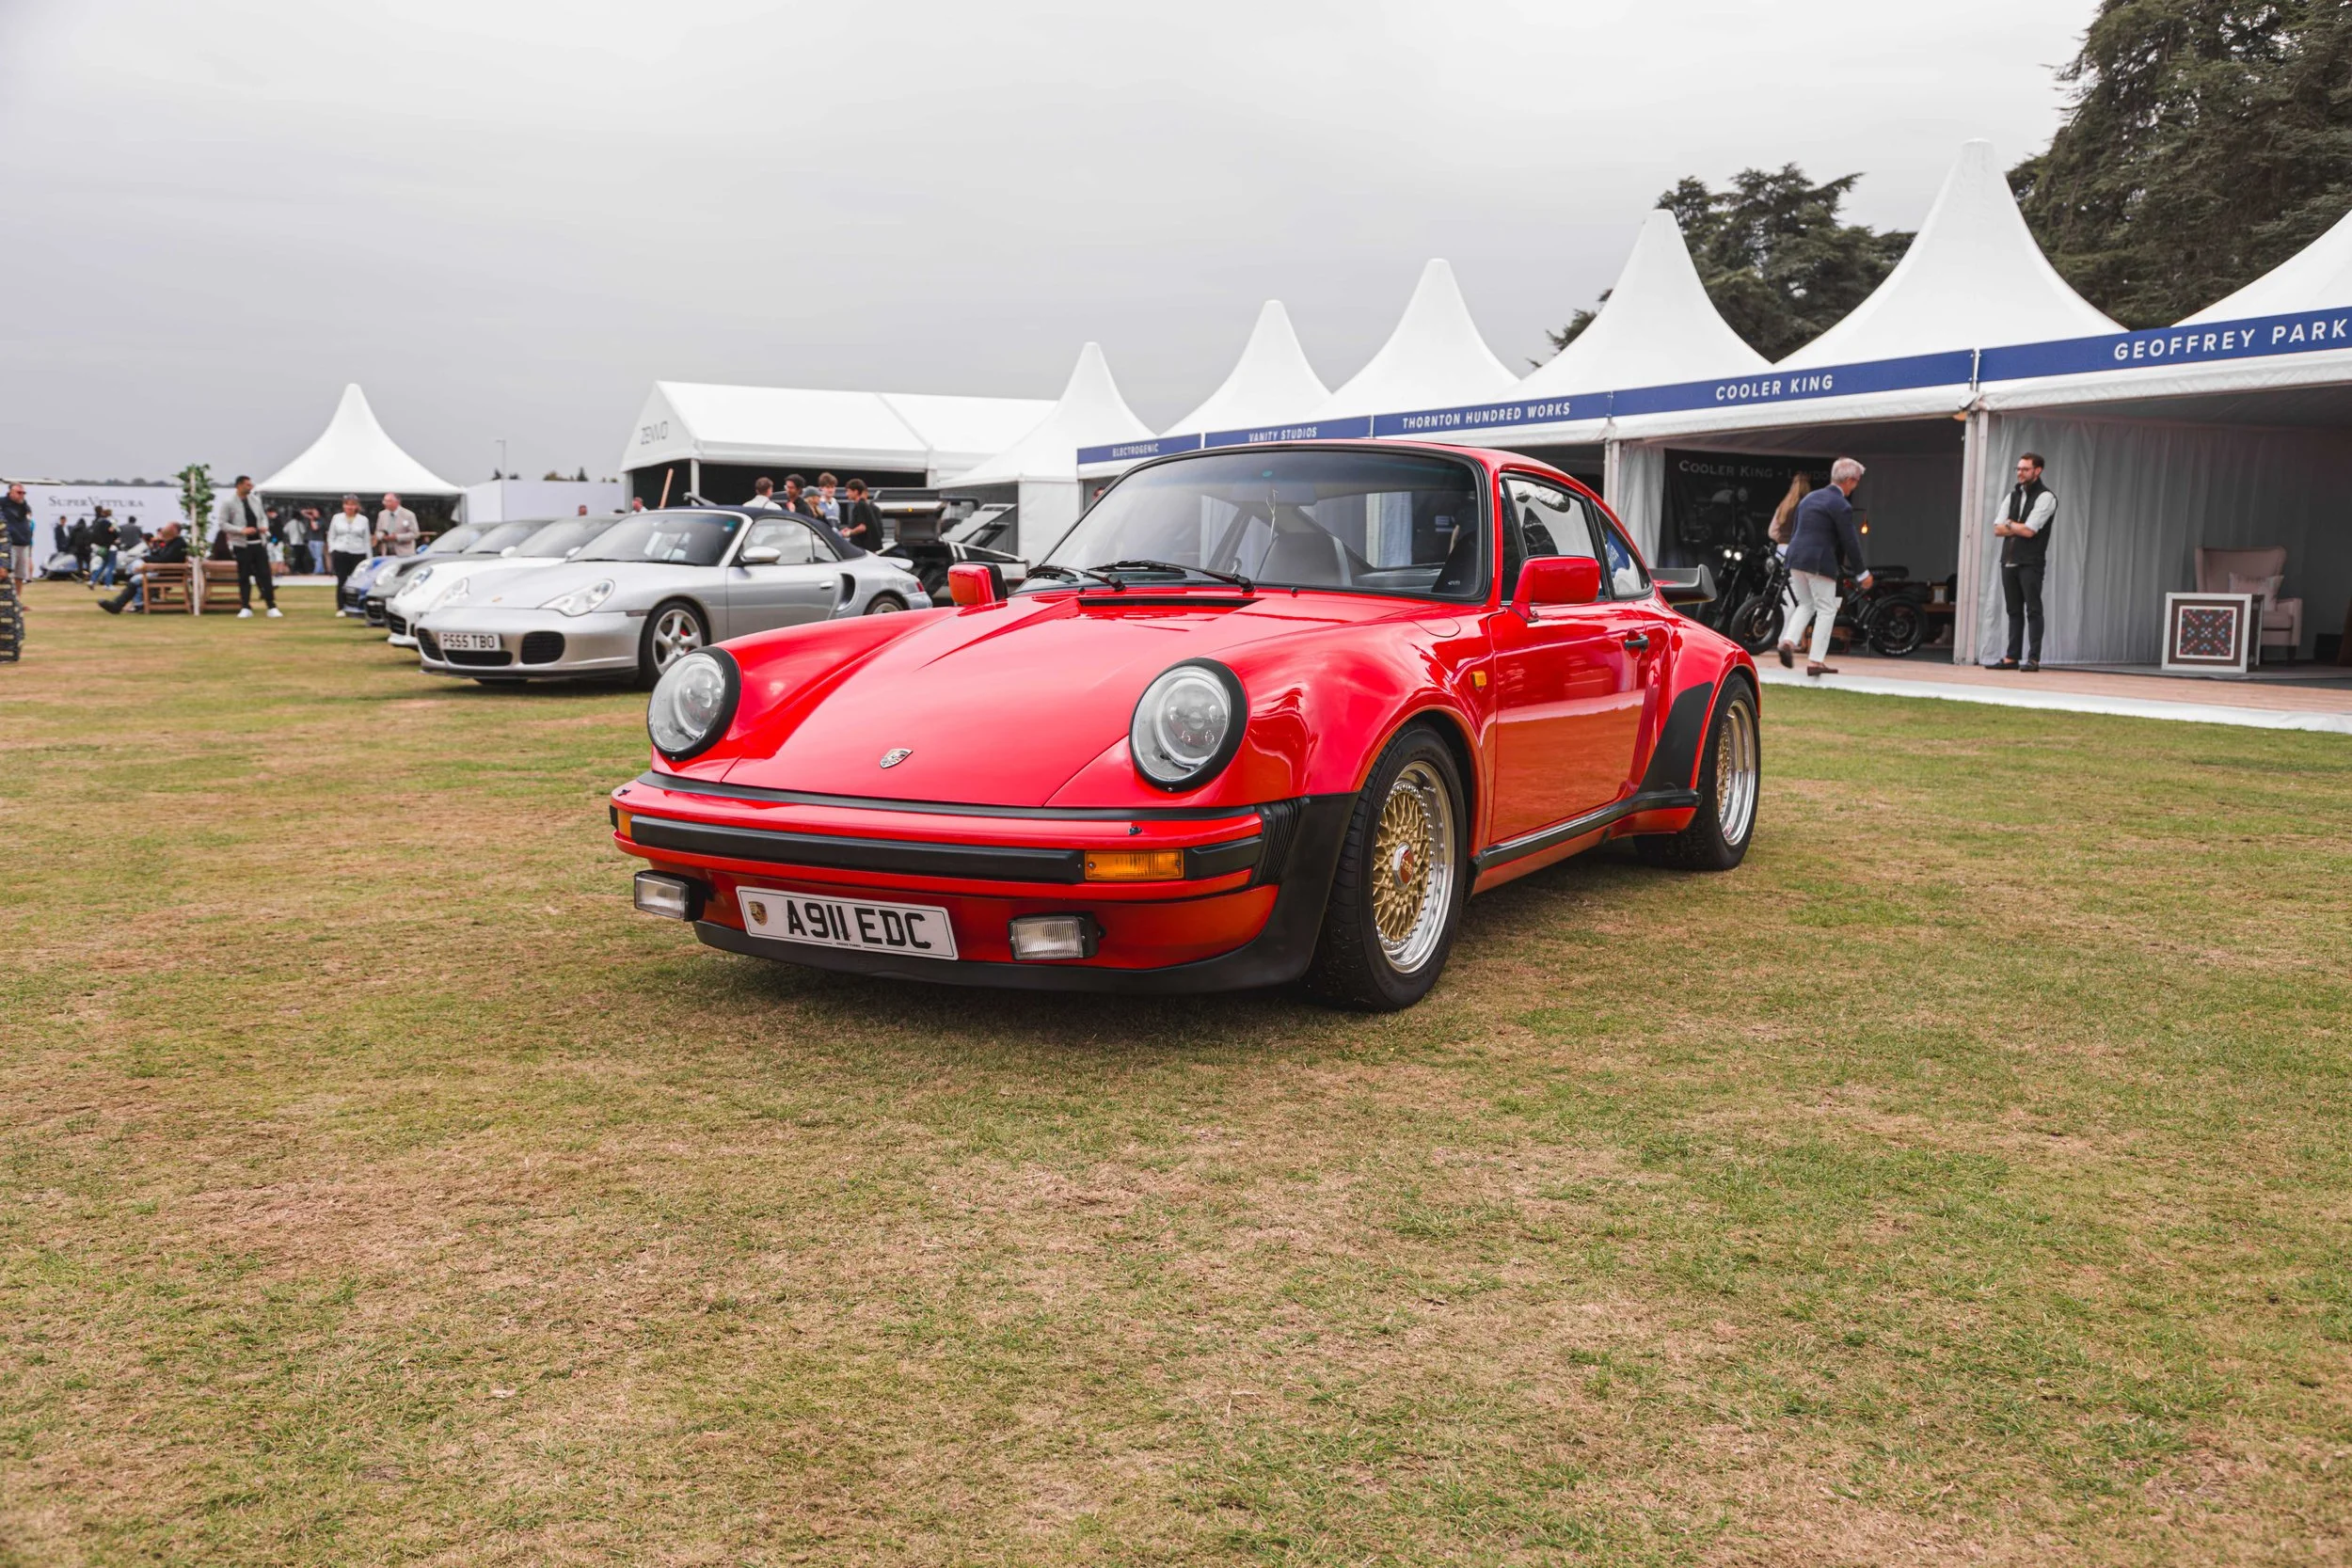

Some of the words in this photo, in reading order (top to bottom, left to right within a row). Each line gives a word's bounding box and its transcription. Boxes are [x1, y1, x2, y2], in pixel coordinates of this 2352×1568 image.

[2114, 328, 2255, 361] GEOFFREY
[2271, 318, 2348, 345] PARK
[1715, 380, 1782, 401] COOLER
[1789, 374, 1834, 393] KING
[1402, 412, 1461, 430] THORNTON
[1465, 406, 1521, 424] HUNDRED
[1527, 402, 1571, 420] WORKS
[1248, 431, 1279, 443] VANITY
[1280, 426, 1318, 440] STUDIOS
[1112, 443, 1160, 458] ELECTROGENIC
[1678, 459, 1735, 477] COOLER
[1740, 465, 1773, 479] KING
[787, 899, 850, 942] A911
[853, 907, 932, 950] EDC
